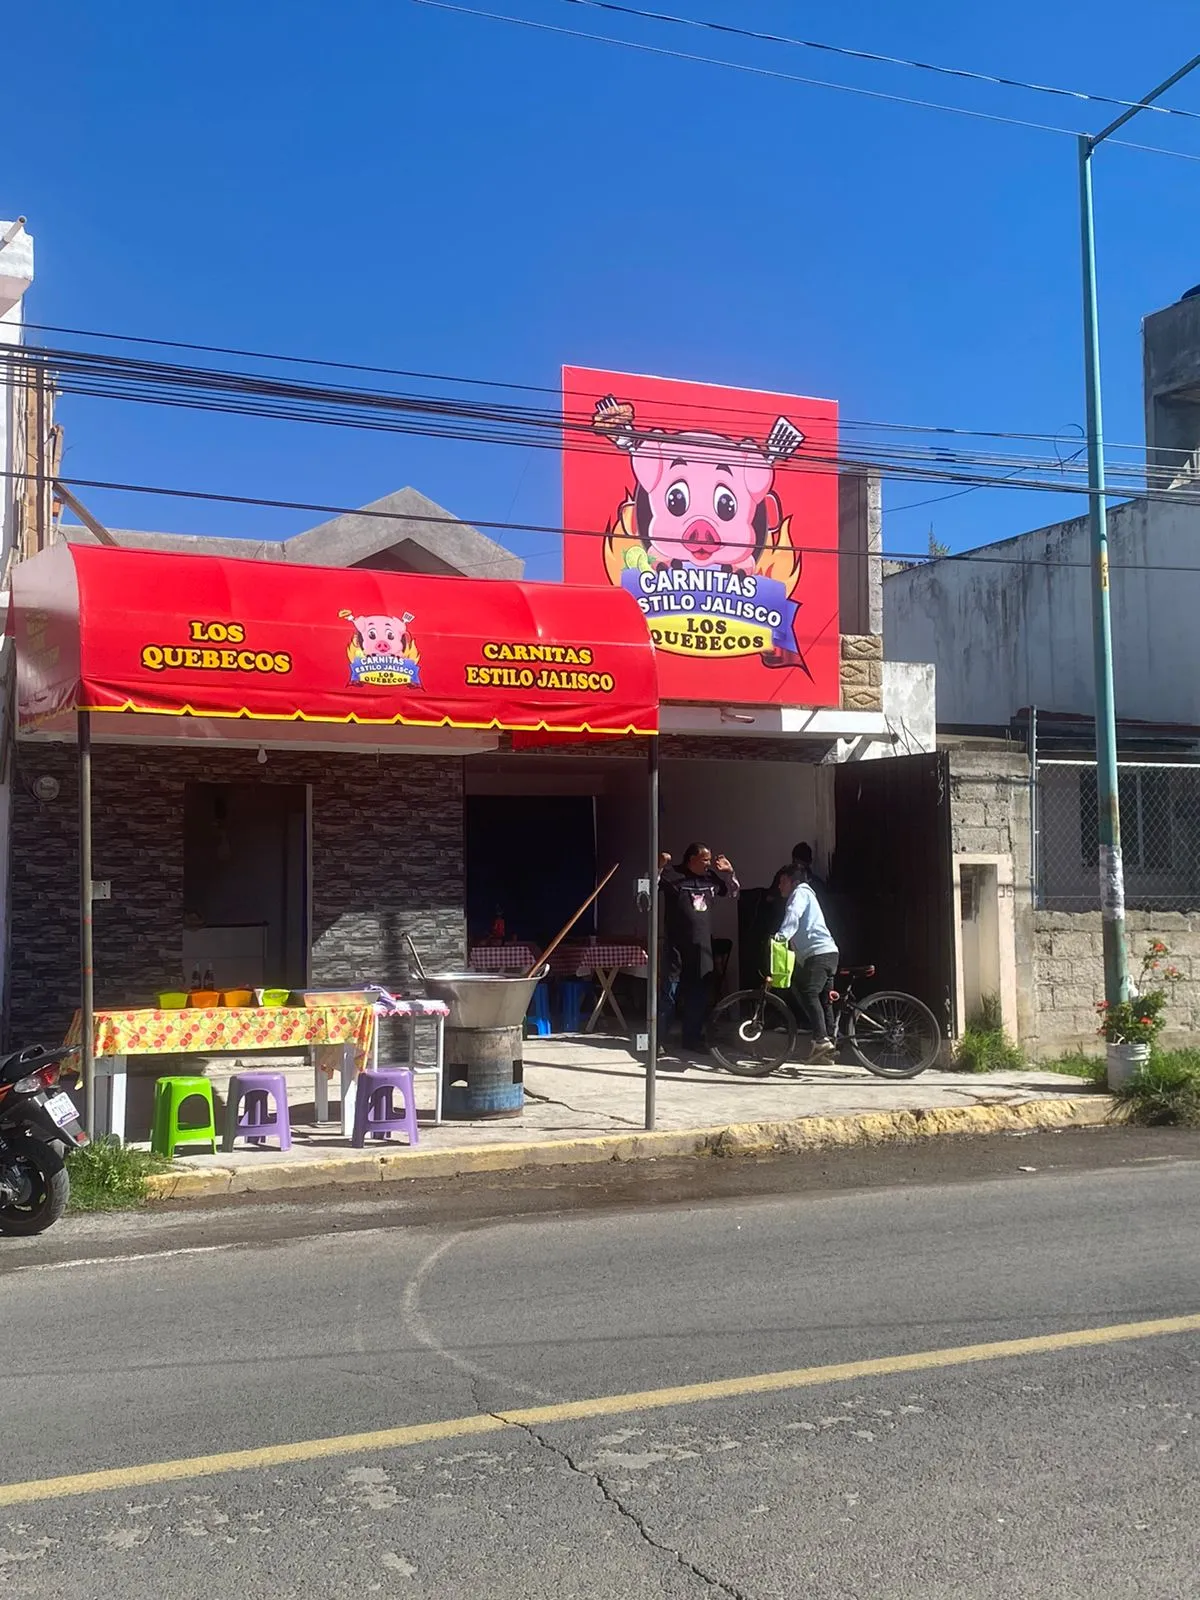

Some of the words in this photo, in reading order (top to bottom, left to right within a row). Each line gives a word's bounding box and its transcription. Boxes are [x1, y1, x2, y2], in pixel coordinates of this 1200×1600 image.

[639, 569, 757, 598] CARNITAS
[637, 594, 695, 613] STILO
[700, 596, 782, 627] JALISCO
[190, 621, 245, 643] LOS
[686, 618, 727, 634] LOS
[650, 629, 764, 651] QUEBECOS
[142, 645, 291, 673] QUEBECOS
[360, 656, 405, 665] CARNITAS
[483, 643, 592, 665] CARNITAS
[355, 664, 382, 673] ESTILO
[383, 665, 414, 675] JALISCO
[466, 666, 534, 687] ESTILO
[537, 670, 614, 691] JALISCO
